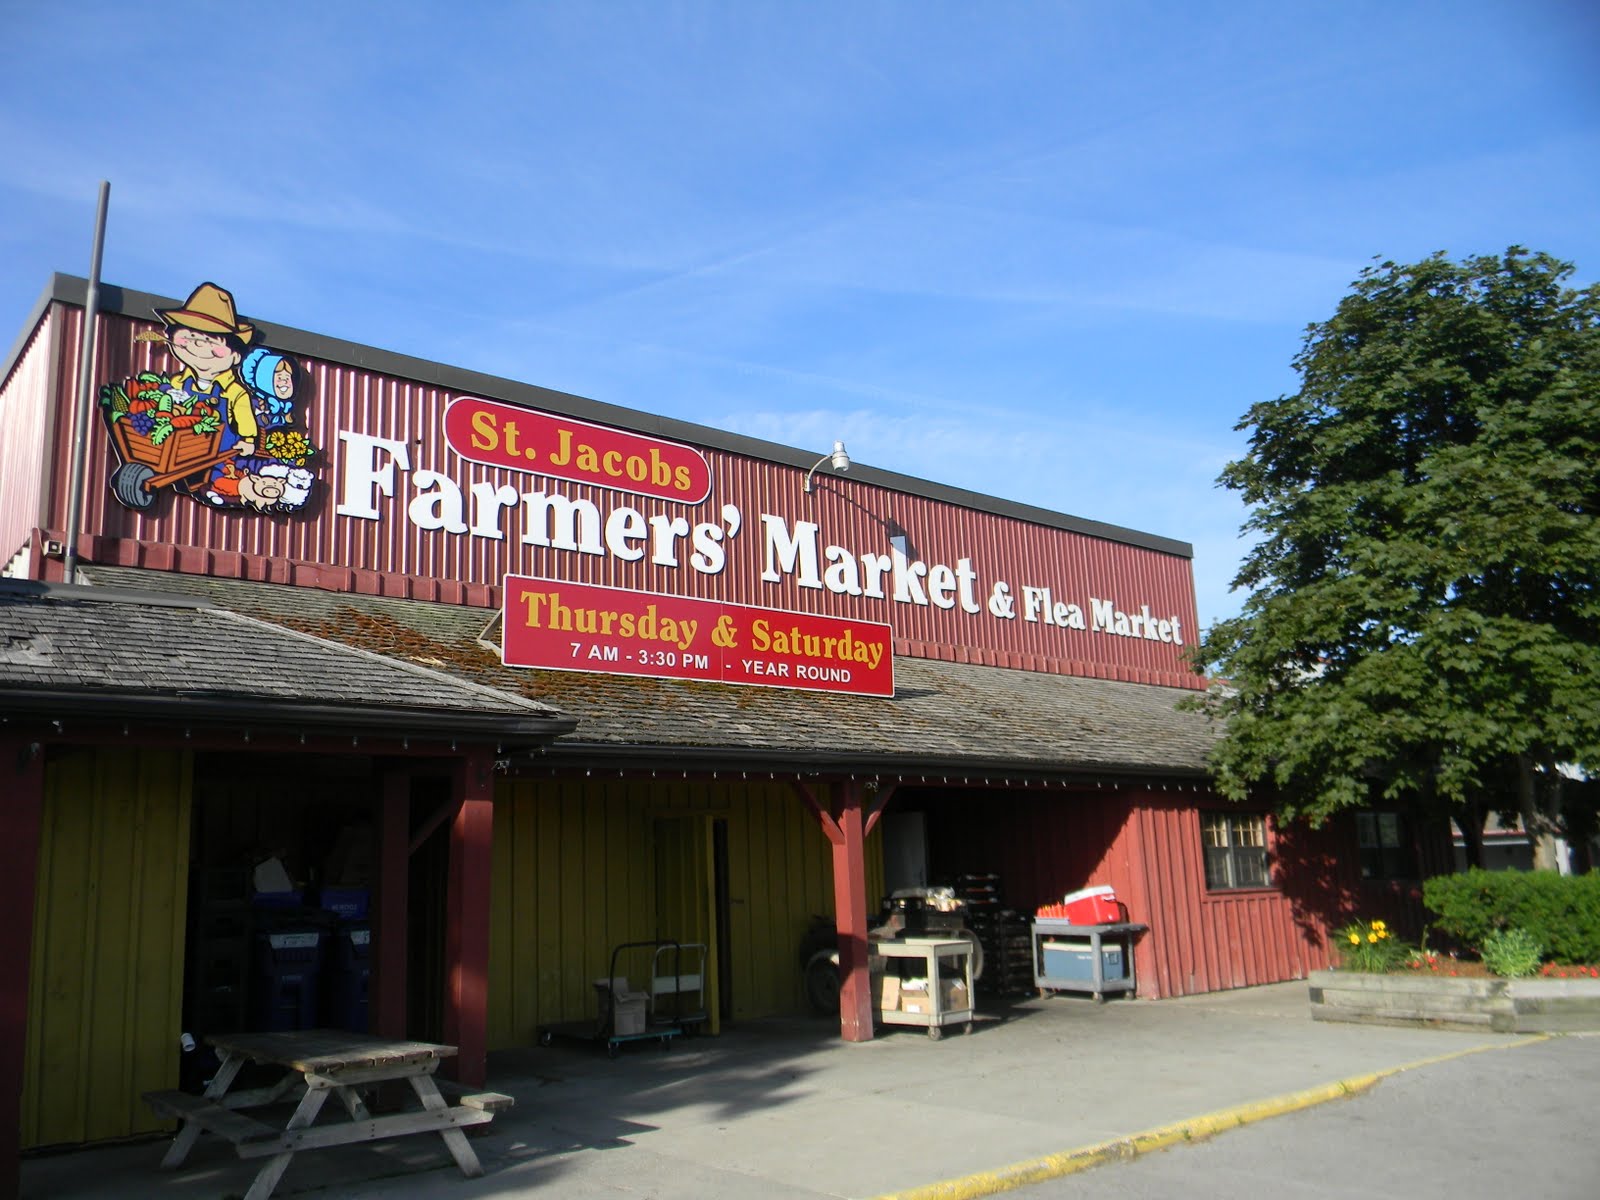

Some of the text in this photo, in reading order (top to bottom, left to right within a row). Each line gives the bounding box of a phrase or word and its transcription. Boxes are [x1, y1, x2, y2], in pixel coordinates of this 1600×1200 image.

[471, 411, 691, 491] St. Jacobs
[337, 430, 1183, 645] Farmers' Market & Flea Market
[520, 591, 883, 669] Thursday & Saturday
[570, 643, 581, 658] 7
[587, 645, 619, 662] AM
[638, 650, 677, 668] 3:30
[682, 654, 709, 670] PM
[741, 660, 789, 678] YEAR
[796, 666, 851, 683] ROUND
